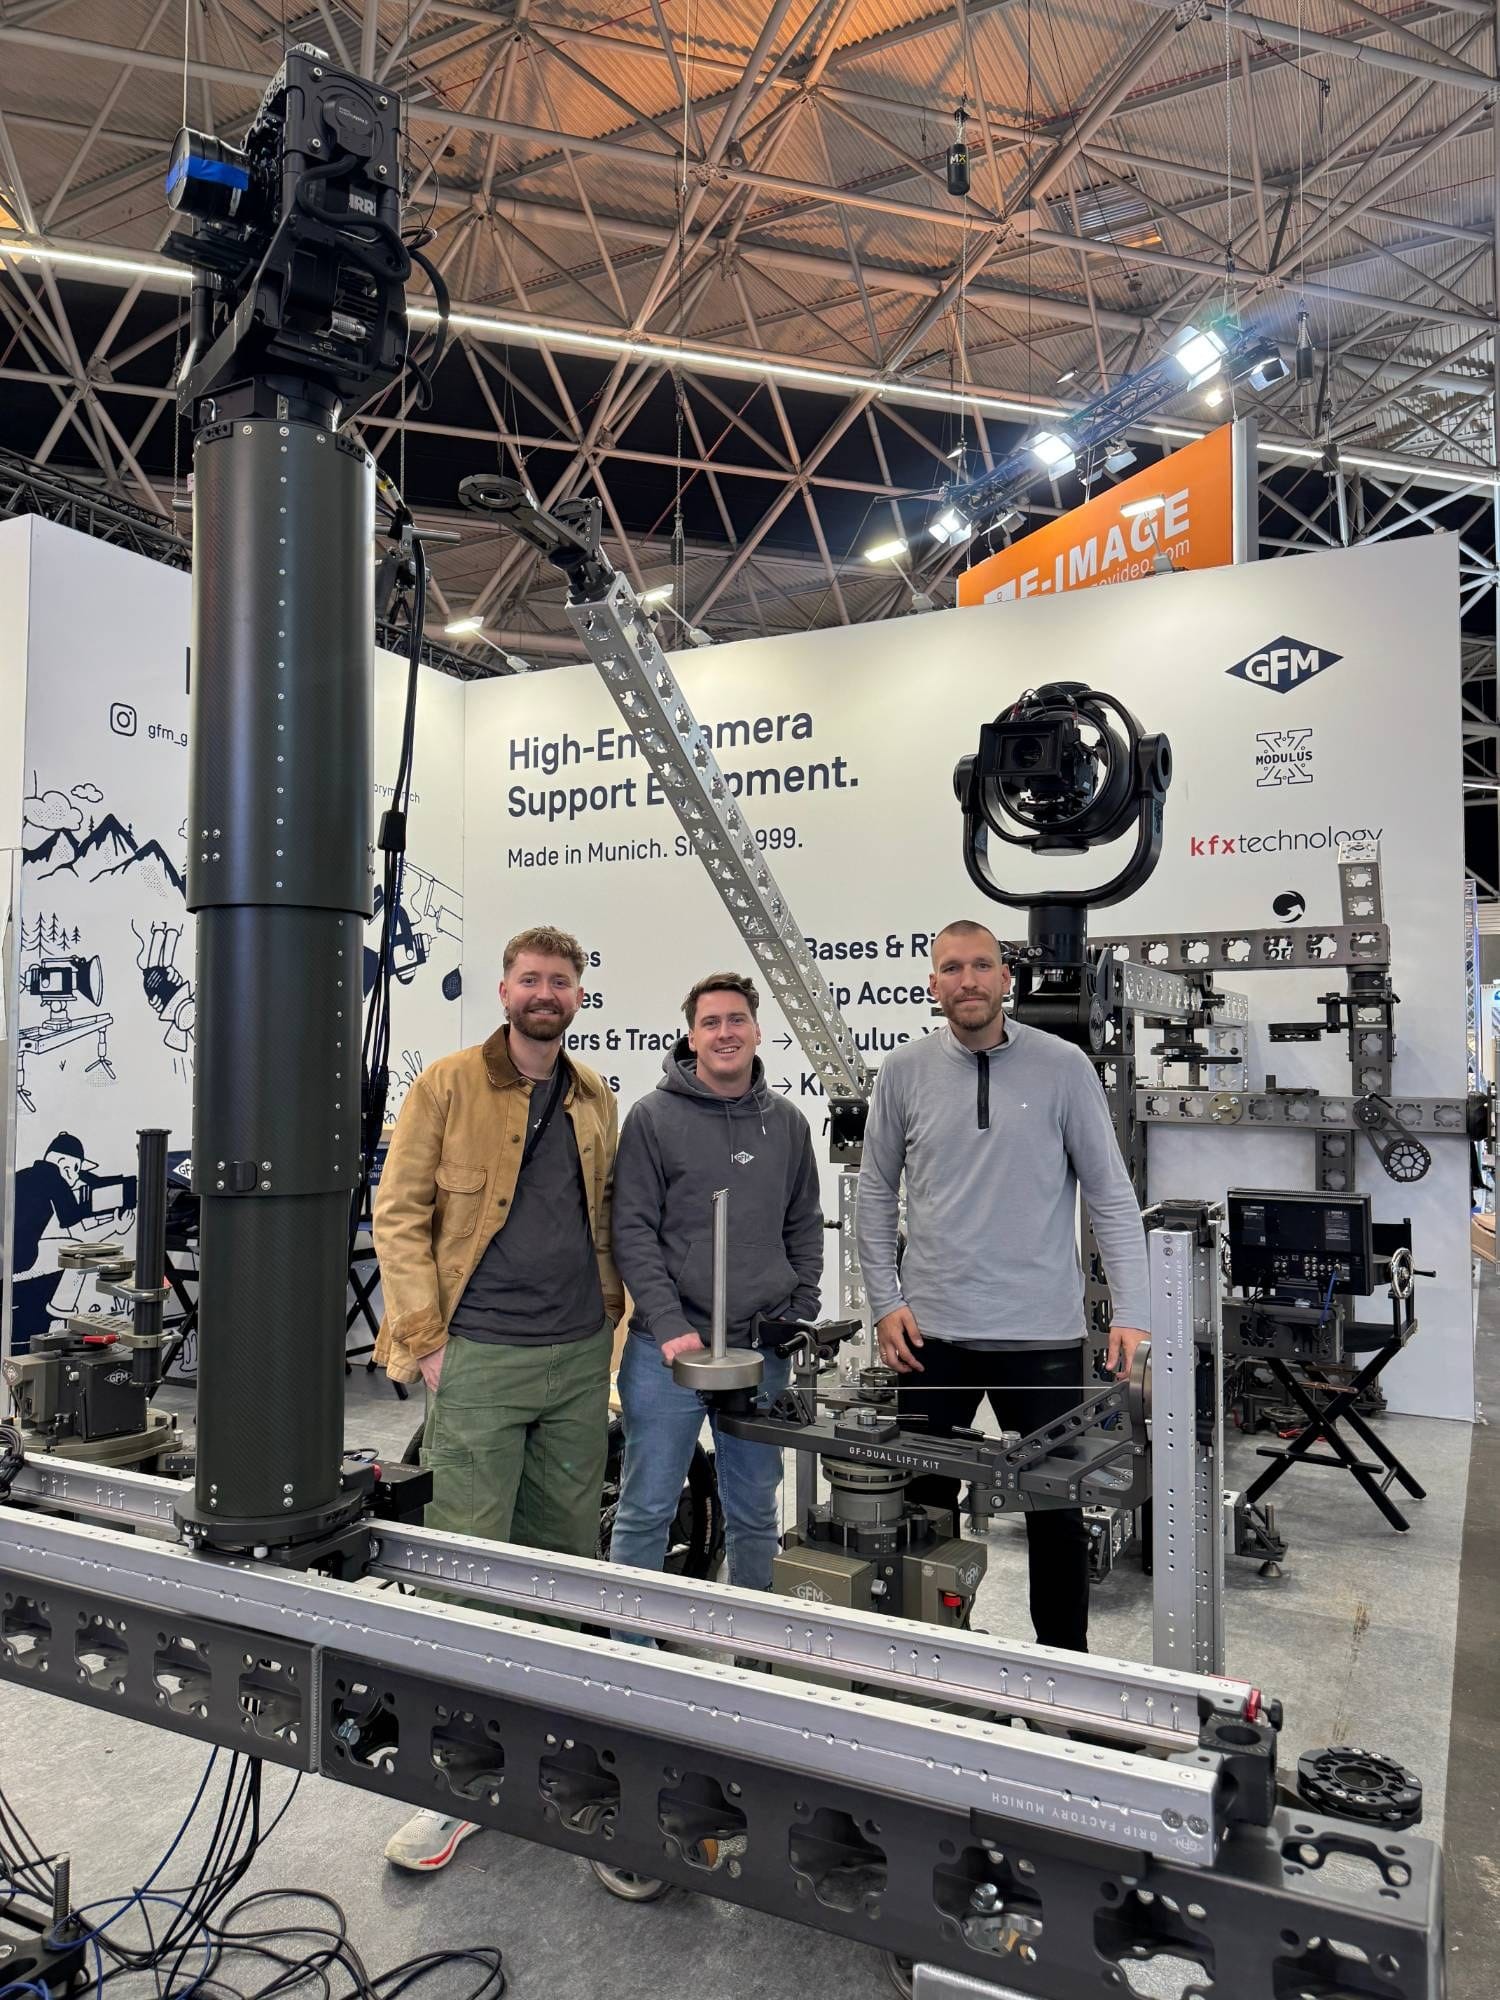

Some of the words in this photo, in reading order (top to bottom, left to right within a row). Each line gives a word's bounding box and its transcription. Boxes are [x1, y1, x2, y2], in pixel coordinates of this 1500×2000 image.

[1244, 648, 1320, 685] GFM
[509, 727, 637, 776] High-En
[699, 712, 813, 749] amera
[1255, 750, 1313, 766] MODULUS
[508, 777, 637, 823] Support
[508, 846, 559, 869] Made
[565, 844, 582, 865] in
[588, 837, 668, 864] Munich.
[755, 826, 803, 851] 999.
[885, 934, 904, 959] &
[606, 1028, 622, 1051] &
[109, 1371, 129, 1383] GFM
[849, 1446, 893, 1462] GF-DUAL
[896, 1454, 919, 1466] LIFT
[922, 1459, 941, 1470] KIT
[796, 1584, 825, 1602] GFM
[991, 1791, 1045, 1814] MUNICH
[1051, 1806, 1116, 1833] FACTORY
[1123, 1827, 1158, 1843] GRIP
